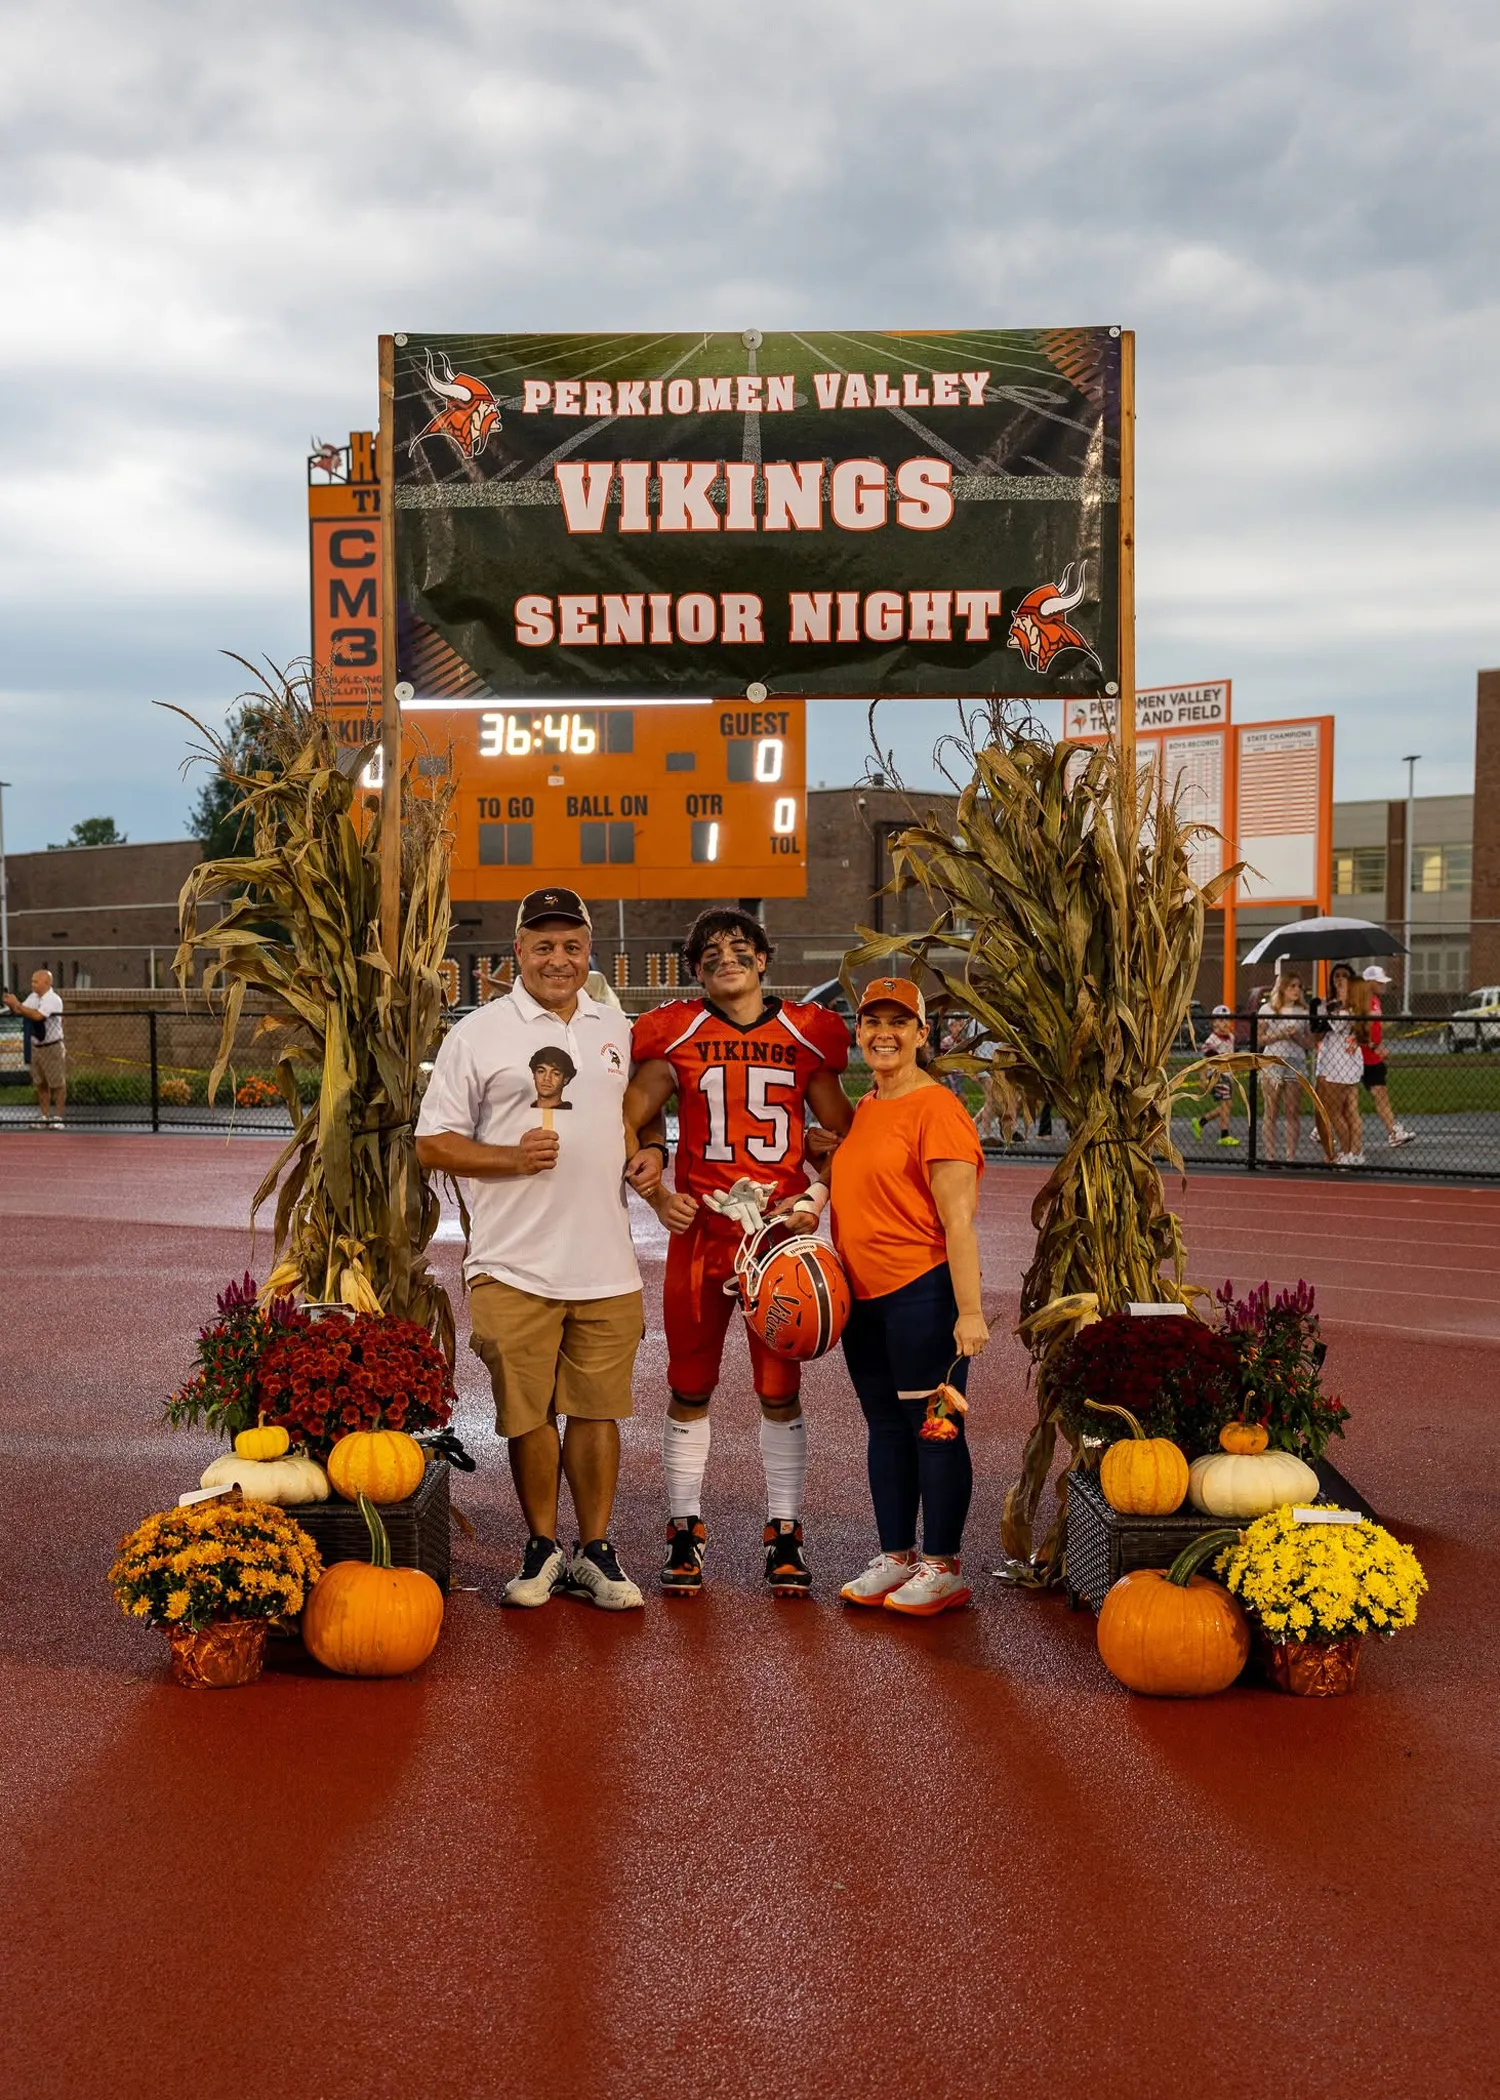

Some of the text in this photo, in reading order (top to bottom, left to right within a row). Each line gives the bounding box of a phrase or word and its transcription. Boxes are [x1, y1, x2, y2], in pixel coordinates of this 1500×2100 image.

[522, 371, 992, 416] PERKIOMEN VALLEY
[555, 458, 956, 534] VIKINGS
[514, 589, 1001, 647] SENIOR NIGHT
[1168, 687, 1222, 705] VALLEY
[719, 712, 789, 736] GUEST
[1141, 709, 1174, 726] AND
[1178, 704, 1222, 721] FIELD
[755, 739, 783, 782] 0
[477, 798, 535, 819] TO GO
[566, 795, 649, 818] BALL ON
[686, 795, 723, 817] QTR
[774, 798, 796, 833] 0
[707, 822, 719, 861] 1
[770, 836, 800, 855] TOL
[695, 1041, 799, 1064] VIKINGS
[699, 1064, 796, 1163] 15
